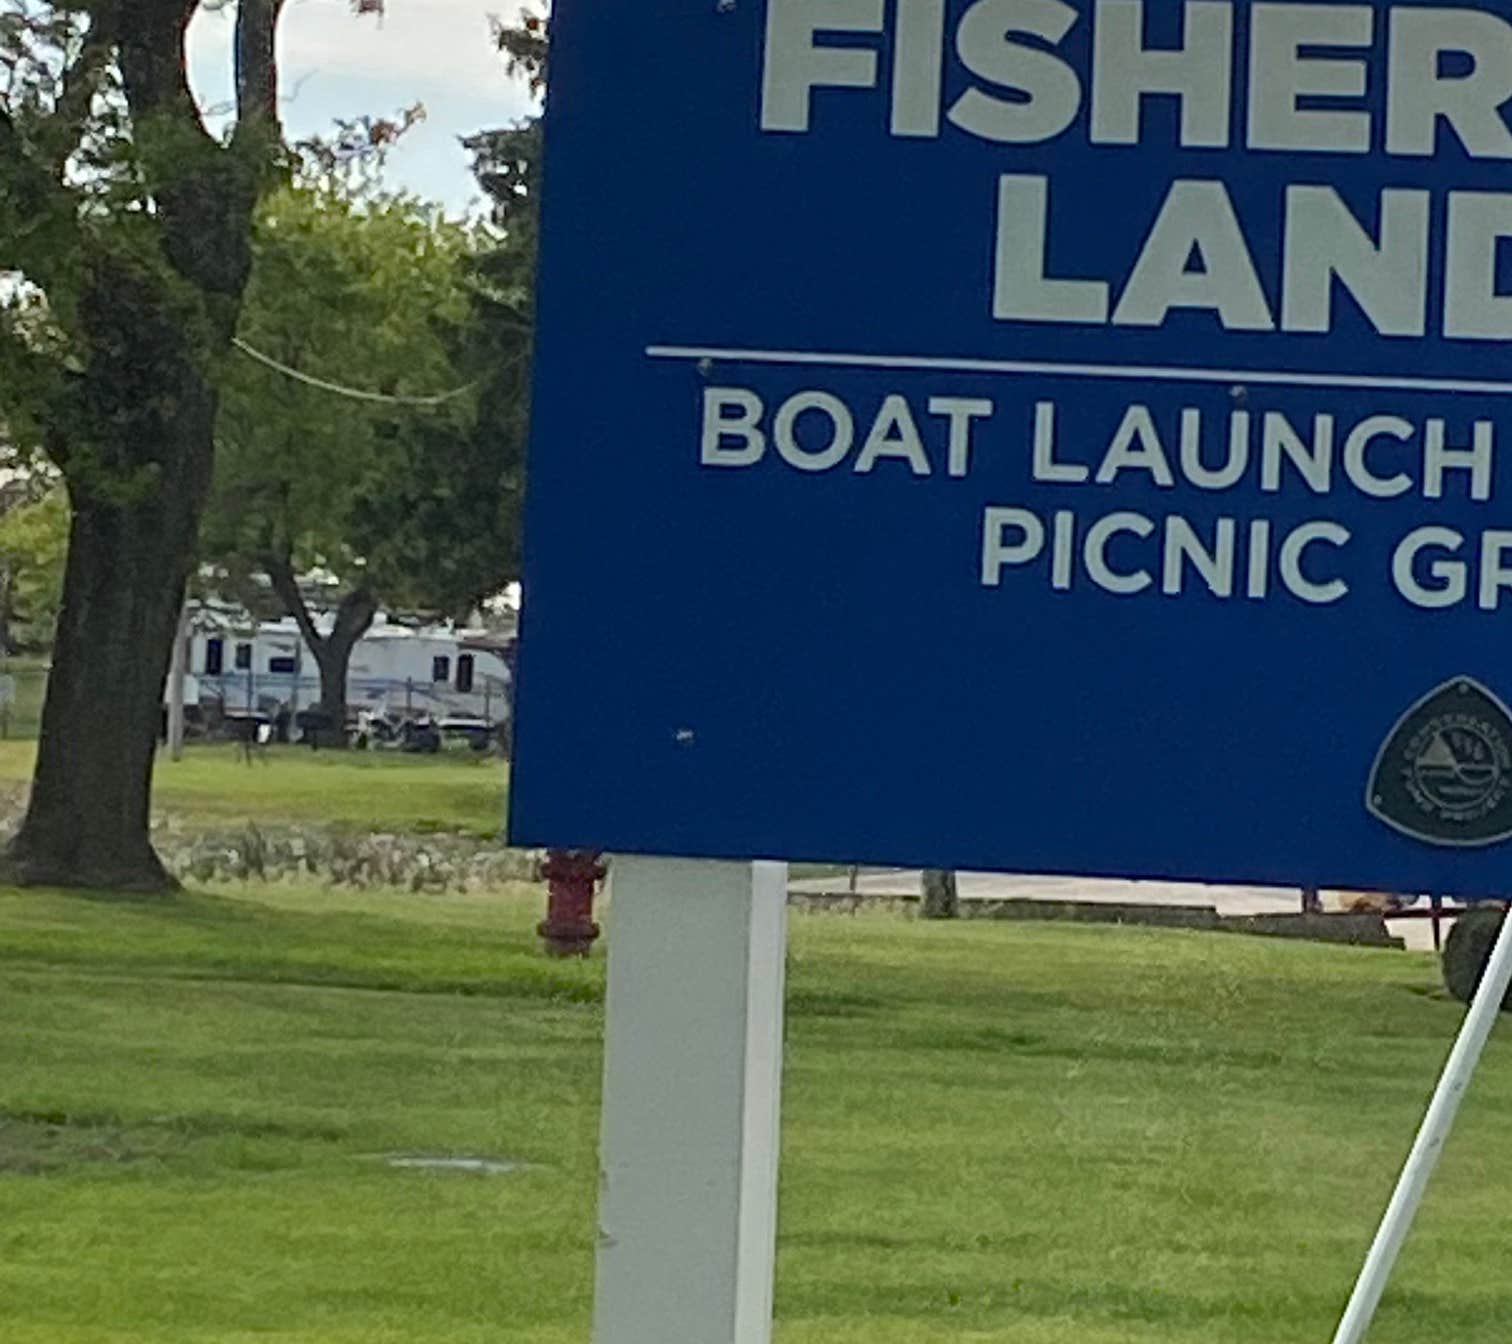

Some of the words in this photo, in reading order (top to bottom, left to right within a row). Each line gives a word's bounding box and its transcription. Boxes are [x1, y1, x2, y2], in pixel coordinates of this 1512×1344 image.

[703, 389, 990, 474] BOAT
[1035, 404, 1491, 498] LAUNCH
[983, 509, 1348, 601] PICNIC
